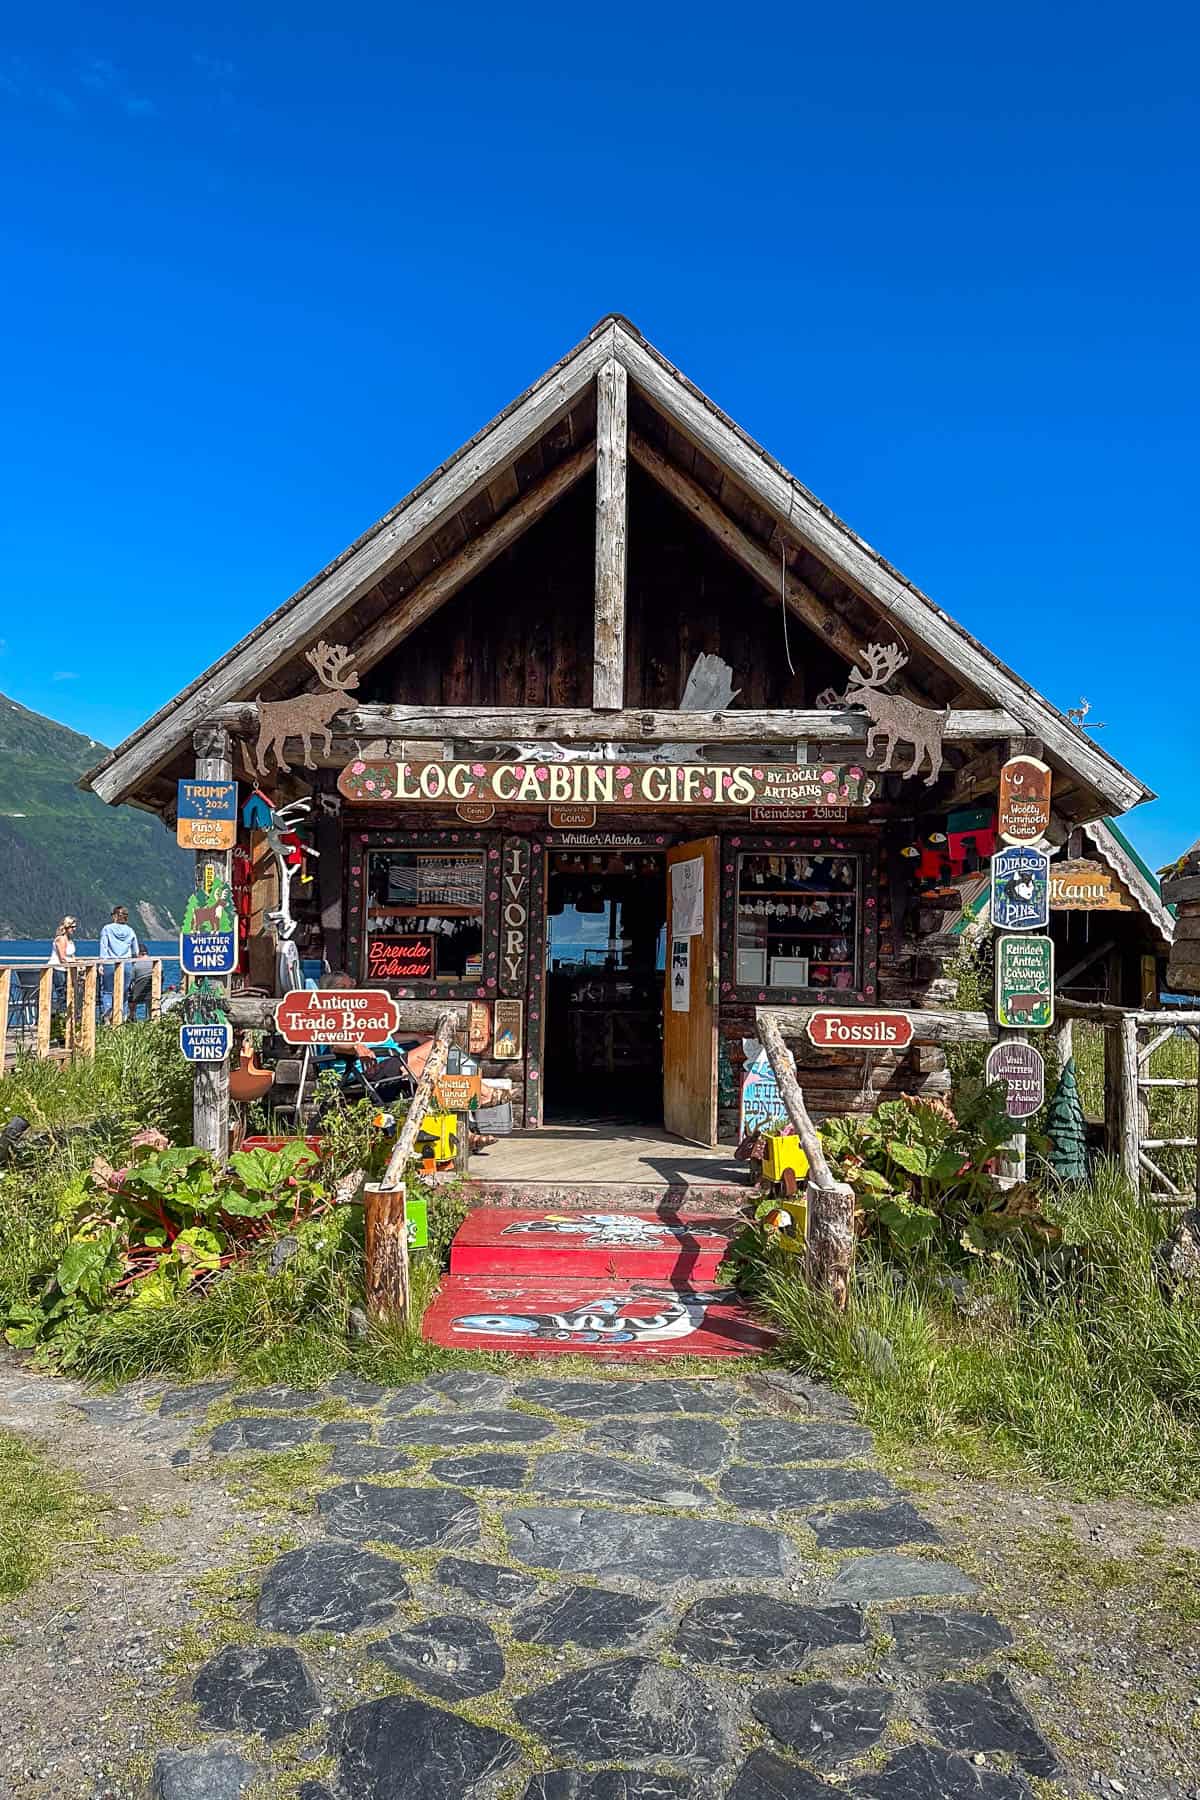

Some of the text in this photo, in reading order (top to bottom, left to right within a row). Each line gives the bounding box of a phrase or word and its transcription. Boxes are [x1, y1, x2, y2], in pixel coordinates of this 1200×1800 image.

[767, 769, 820, 783] BY LOCAL
[394, 763, 756, 804] LOG CABIN GIFTS
[184, 785, 228, 798] TRUMP
[764, 784, 822, 799] ARTISANS
[206, 801, 229, 809] 2024
[1010, 803, 1040, 814] Woolly
[560, 812, 586, 823] Coins
[754, 807, 845, 819] Reindeer Blvd.
[1002, 813, 1047, 824] Mammoth
[995, 857, 1047, 876] IDITAROD
[504, 850, 526, 981] IVORY
[1006, 904, 1036, 922] PINS
[190, 937, 230, 945] WHITTIER
[193, 945, 228, 953] ALASKA
[369, 941, 431, 958] Brenda
[1006, 944, 1044, 955] Reindeer
[193, 954, 225, 967] PINS
[370, 959, 430, 977] Tolman
[308, 991, 368, 1012] Antique
[286, 1012, 390, 1030] Trade Bead
[187, 1028, 224, 1036] WHITTIER
[824, 1019, 897, 1041] Fossils
[188, 1037, 222, 1045] ALASKA
[310, 1030, 365, 1044] Jewelry
[193, 1046, 223, 1058] PINS
[1006, 1055, 1023, 1064] Visit
[998, 1066, 1033, 1074] WHITTIER
[990, 1073, 1041, 1091] MSEUM
